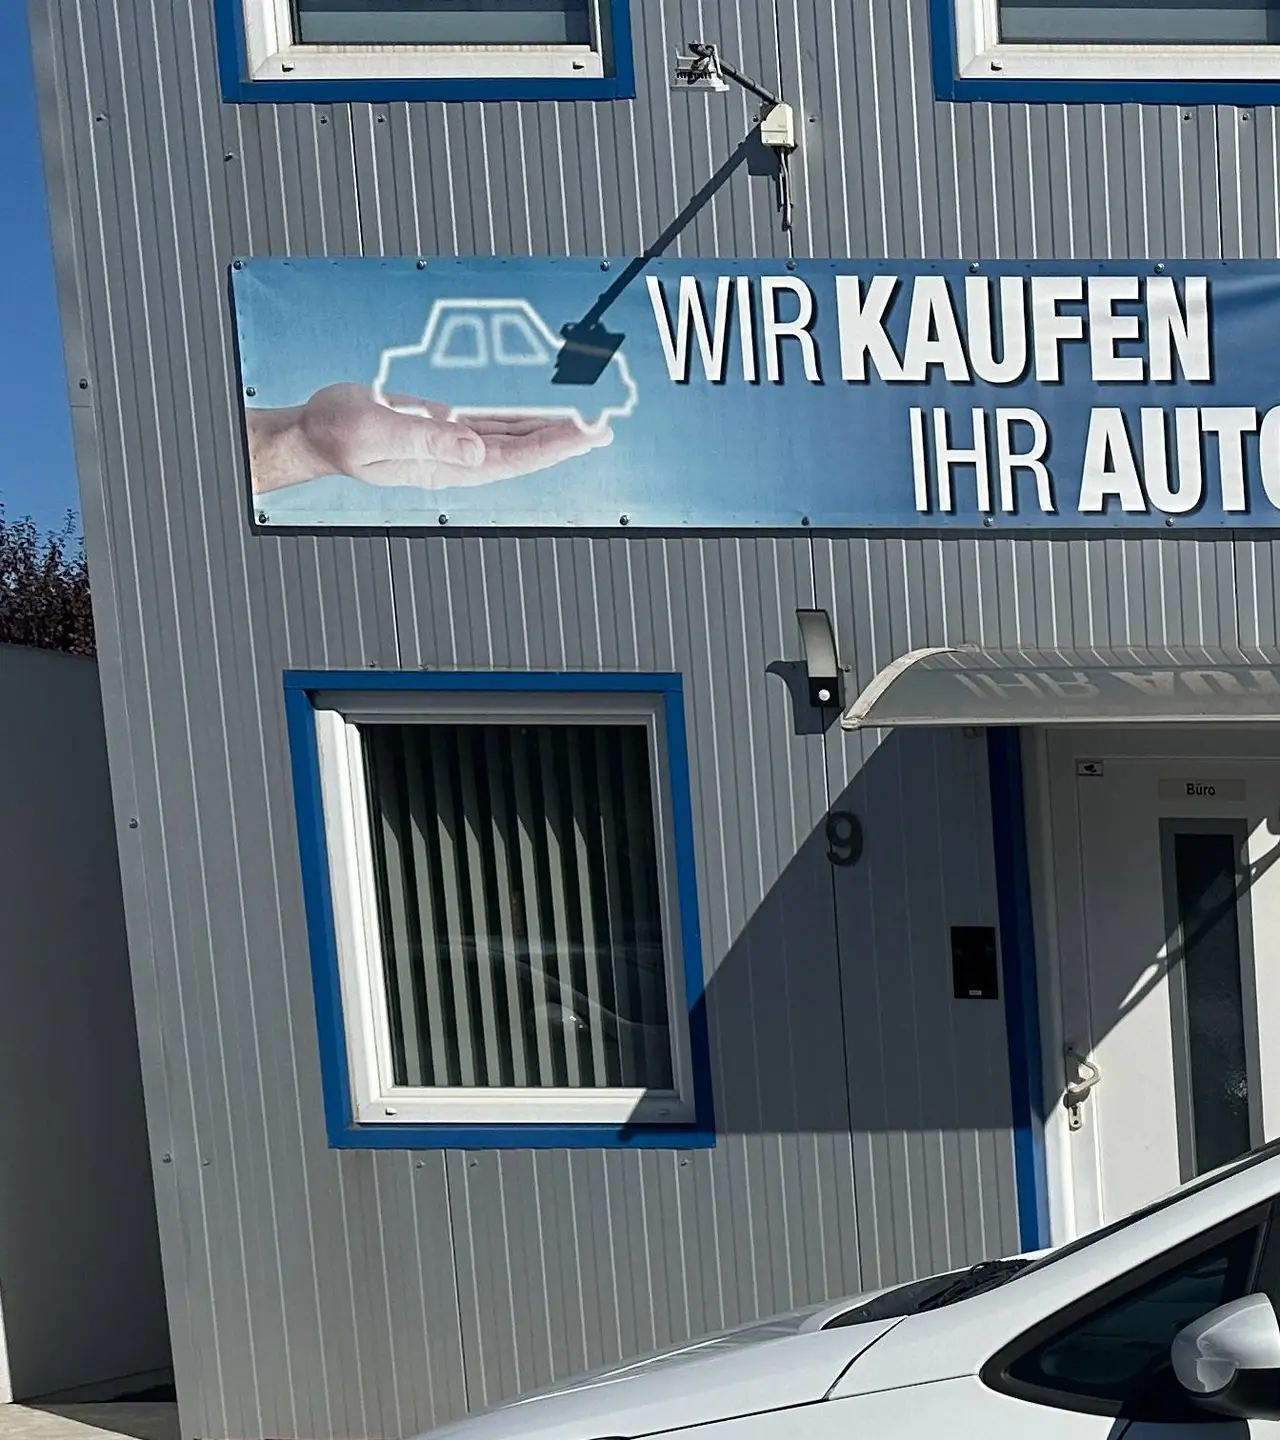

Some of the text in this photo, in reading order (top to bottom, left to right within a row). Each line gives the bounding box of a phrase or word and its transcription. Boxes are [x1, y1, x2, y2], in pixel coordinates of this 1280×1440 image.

[646, 275, 1211, 384] WIR KAUFEN
[908, 407, 1054, 512] IHR
[1186, 782, 1216, 796] Büro
[826, 811, 863, 866] 9
